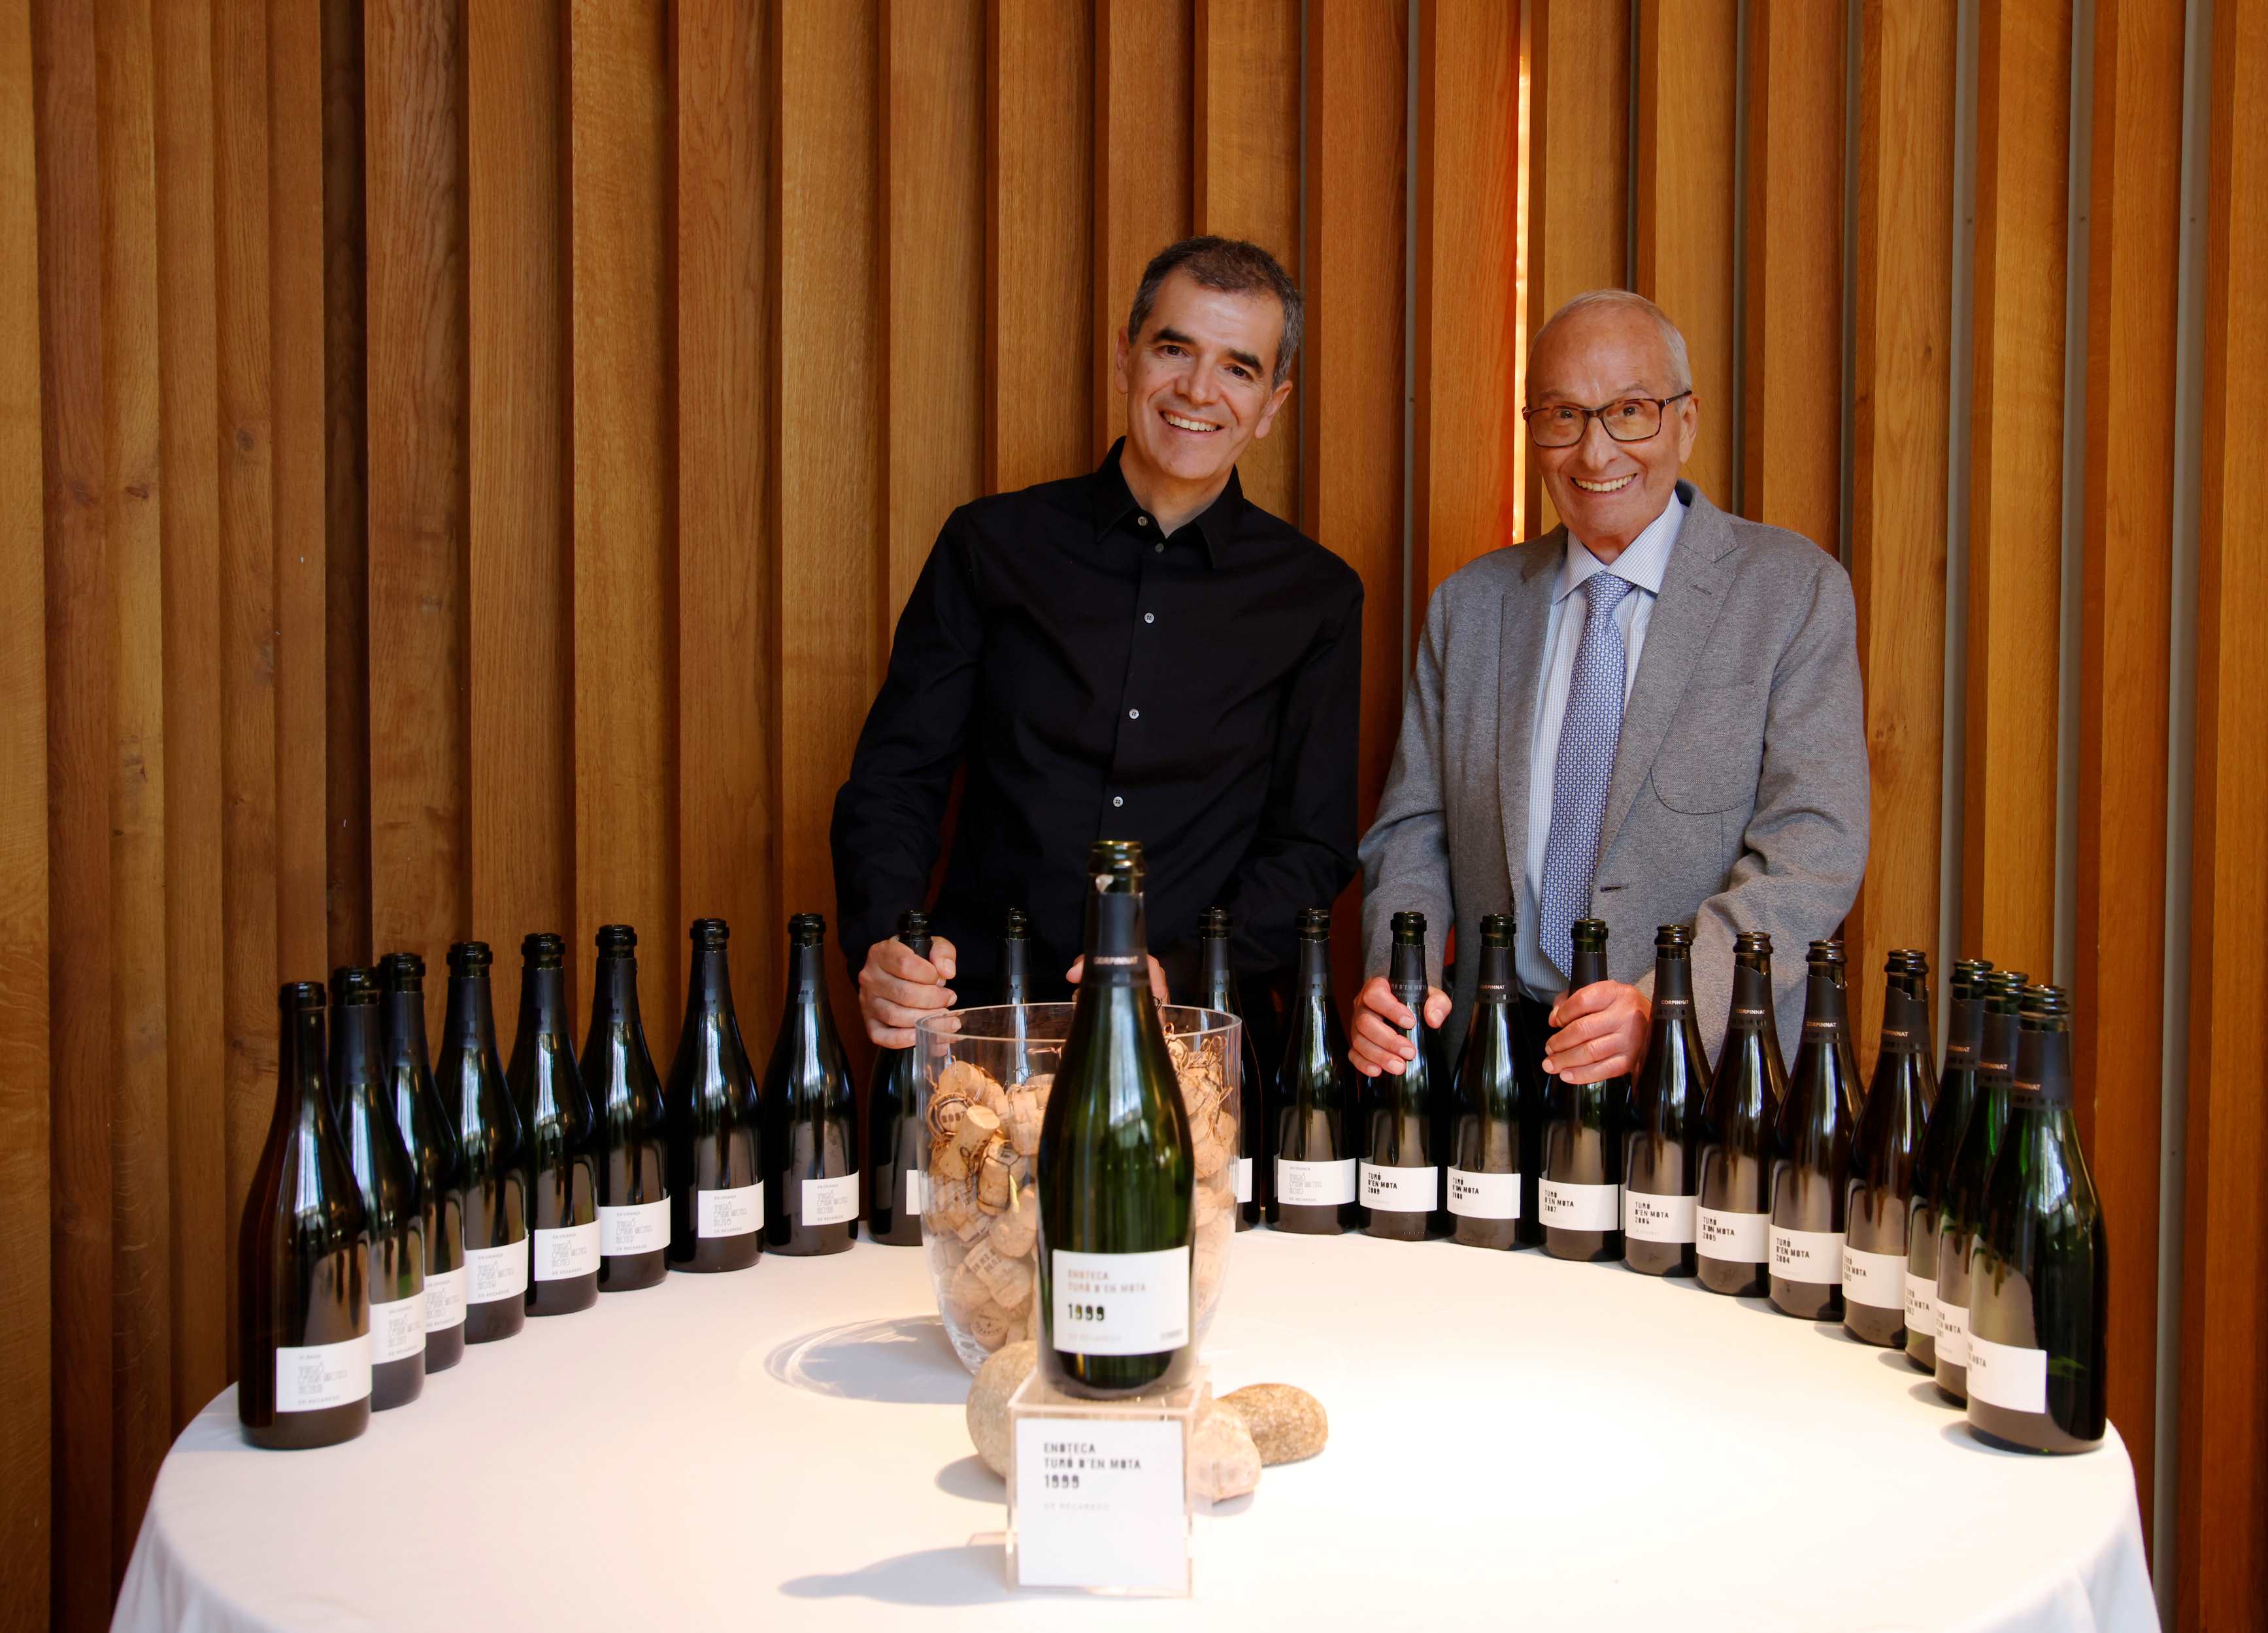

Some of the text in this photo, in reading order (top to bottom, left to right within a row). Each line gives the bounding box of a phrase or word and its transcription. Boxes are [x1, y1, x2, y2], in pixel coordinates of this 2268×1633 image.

[1368, 1172, 1380, 1180] TURÓ
[1452, 1176, 1463, 1185] TURÓ
[1544, 1204, 1556, 1213] 2007
[1557, 1199, 1574, 1208] MOTA
[1703, 1216, 1716, 1225] TURÓ
[1716, 1227, 1735, 1236] MOTA
[1703, 1232, 1716, 1242] 2005
[1776, 1237, 1790, 1247] TURÓ
[1791, 1249, 1809, 1259] MOTA
[1776, 1255, 1790, 1264] 2004
[1067, 1268, 1109, 1279] ENOTECA
[1852, 1266, 1867, 1277] MOTA
[1121, 1283, 1146, 1293] MOTA
[1914, 1300, 1929, 1311] MOTA
[1067, 1303, 1105, 1321] 1999
[1044, 1443, 1095, 1453] ENOTECA
[1044, 1455, 1073, 1468] TURÓ
[1110, 1458, 1141, 1469] MOTA
[1044, 1474, 1080, 1489] 1999
